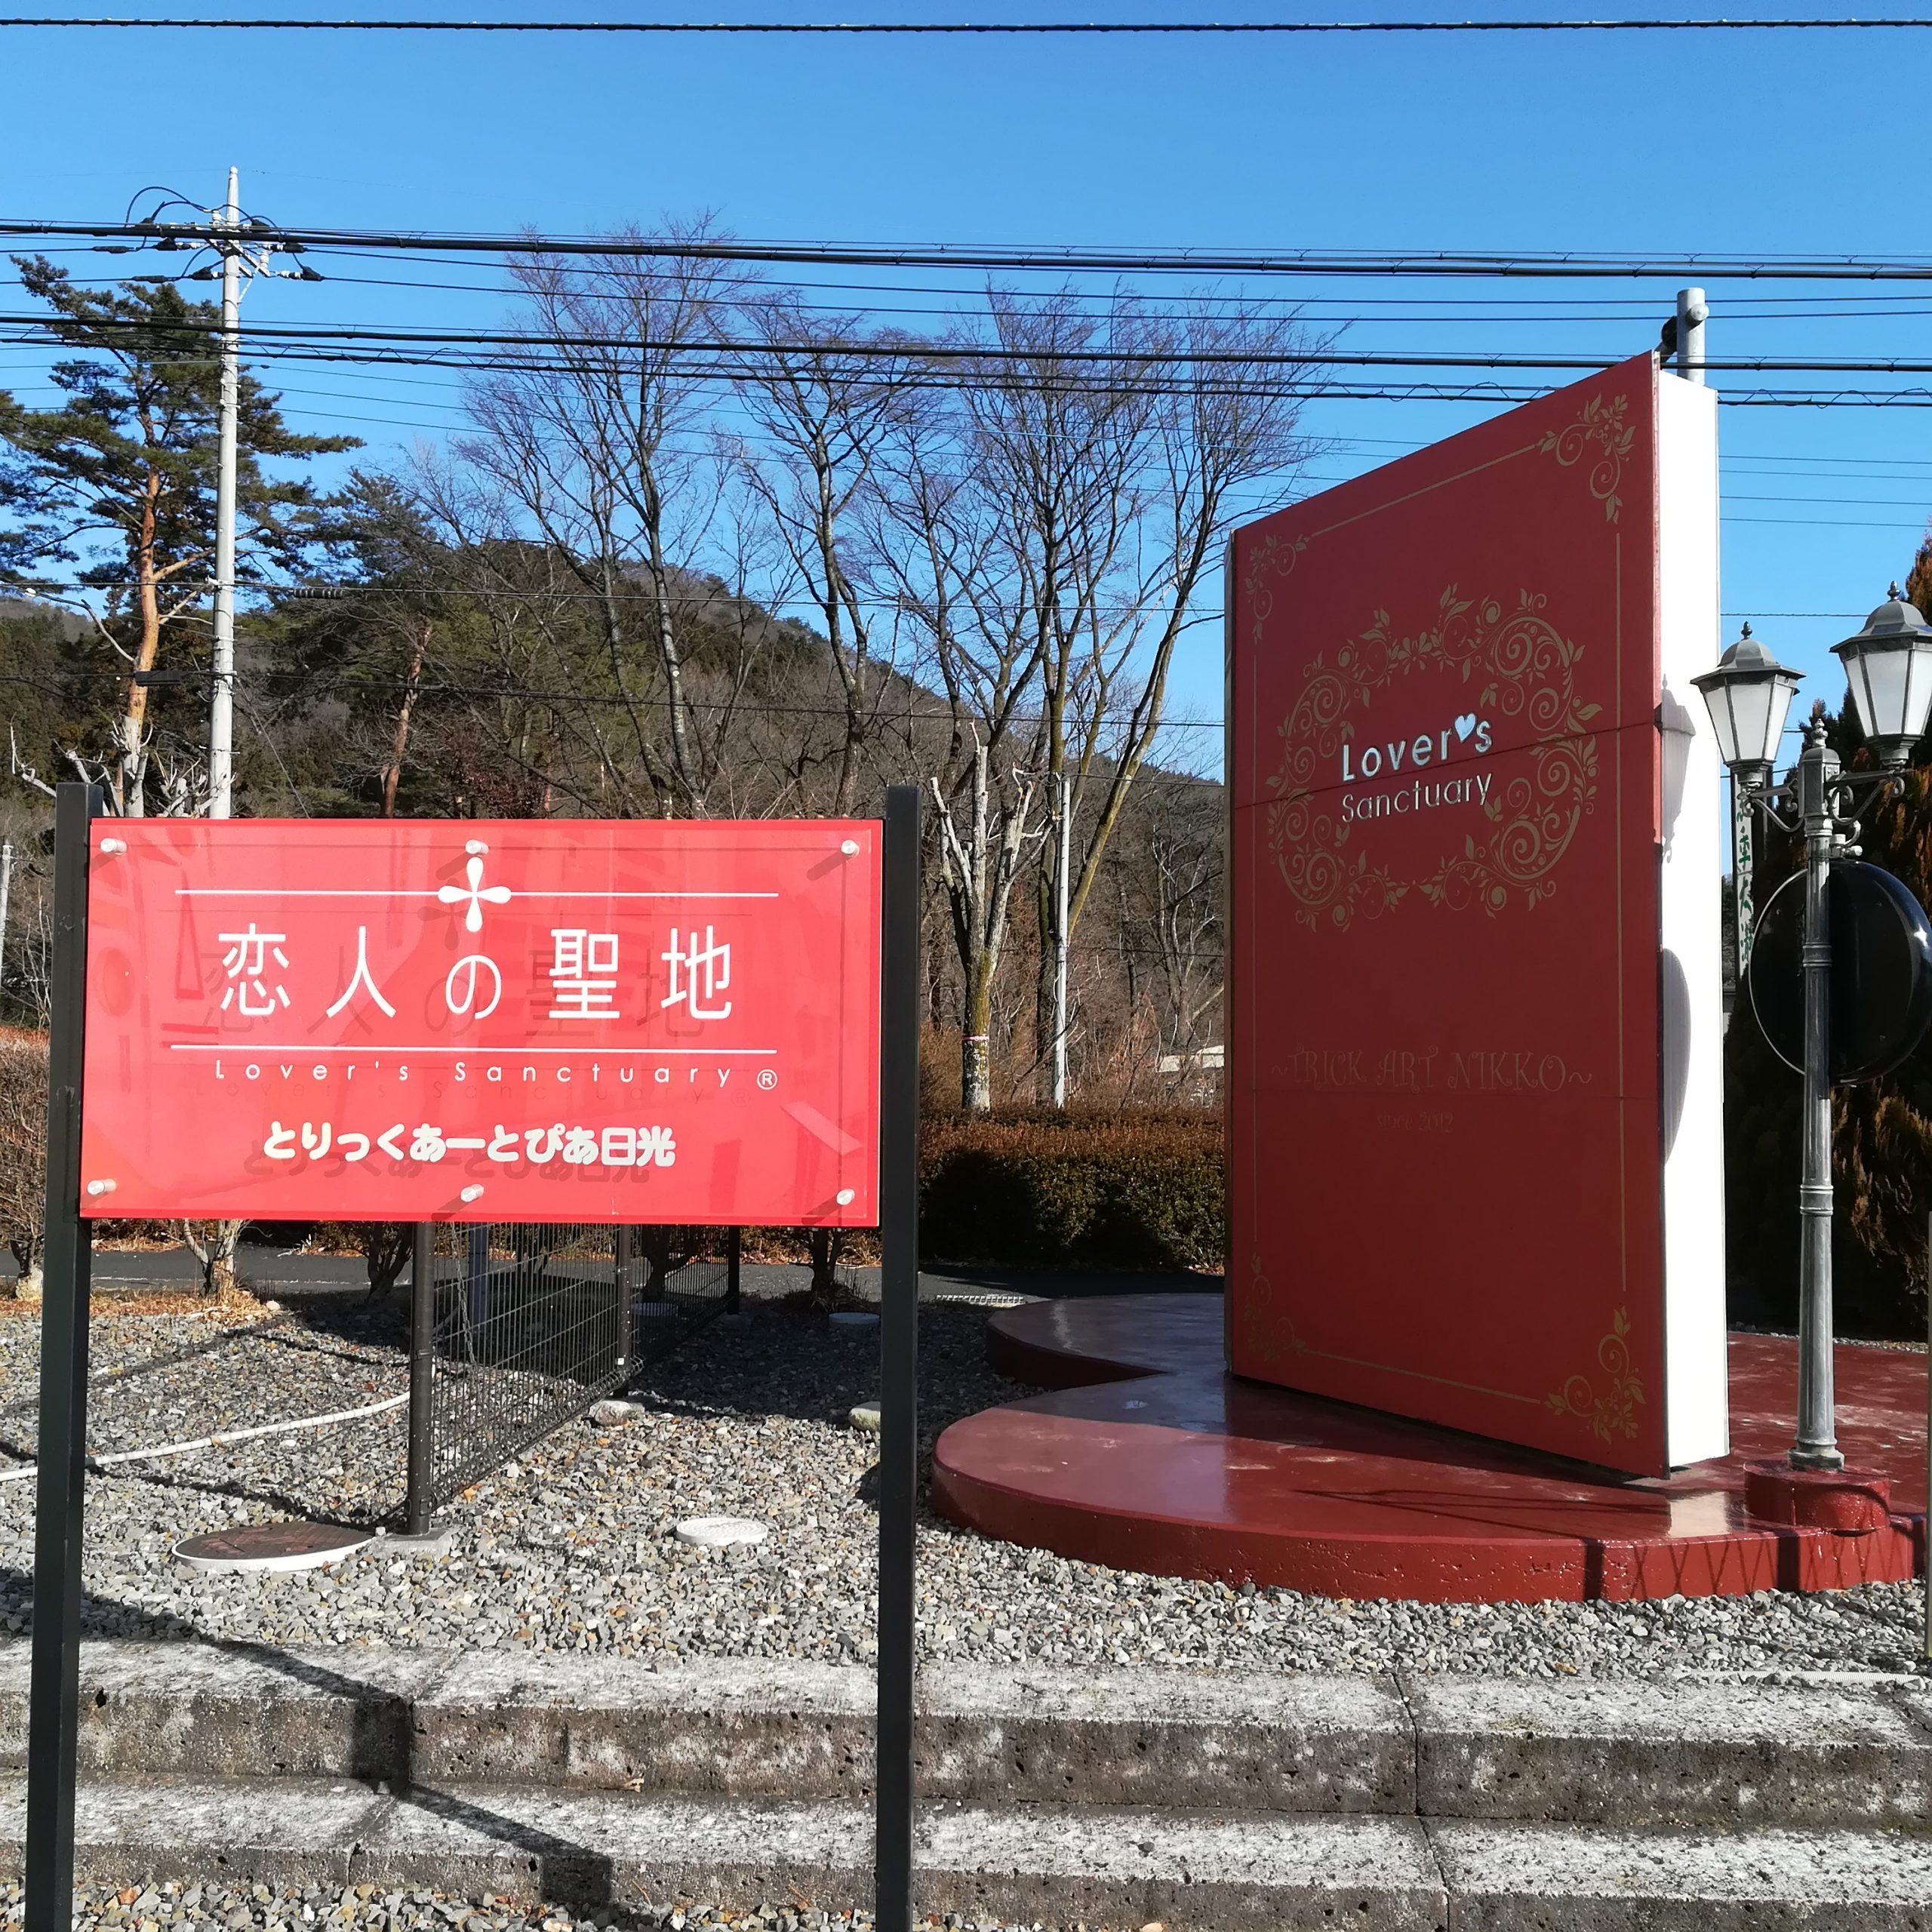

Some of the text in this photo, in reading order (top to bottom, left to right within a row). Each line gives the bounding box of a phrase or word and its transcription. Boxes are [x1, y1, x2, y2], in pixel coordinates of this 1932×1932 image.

[1342, 773, 1493, 823] Sanctuary
[218, 922, 733, 1020] 恋人の聖地
[215, 1059, 408, 1081] Lover's
[1377, 1044, 1438, 1093] ART
[264, 1121, 676, 1167] とりっくあーとぴあ日光
